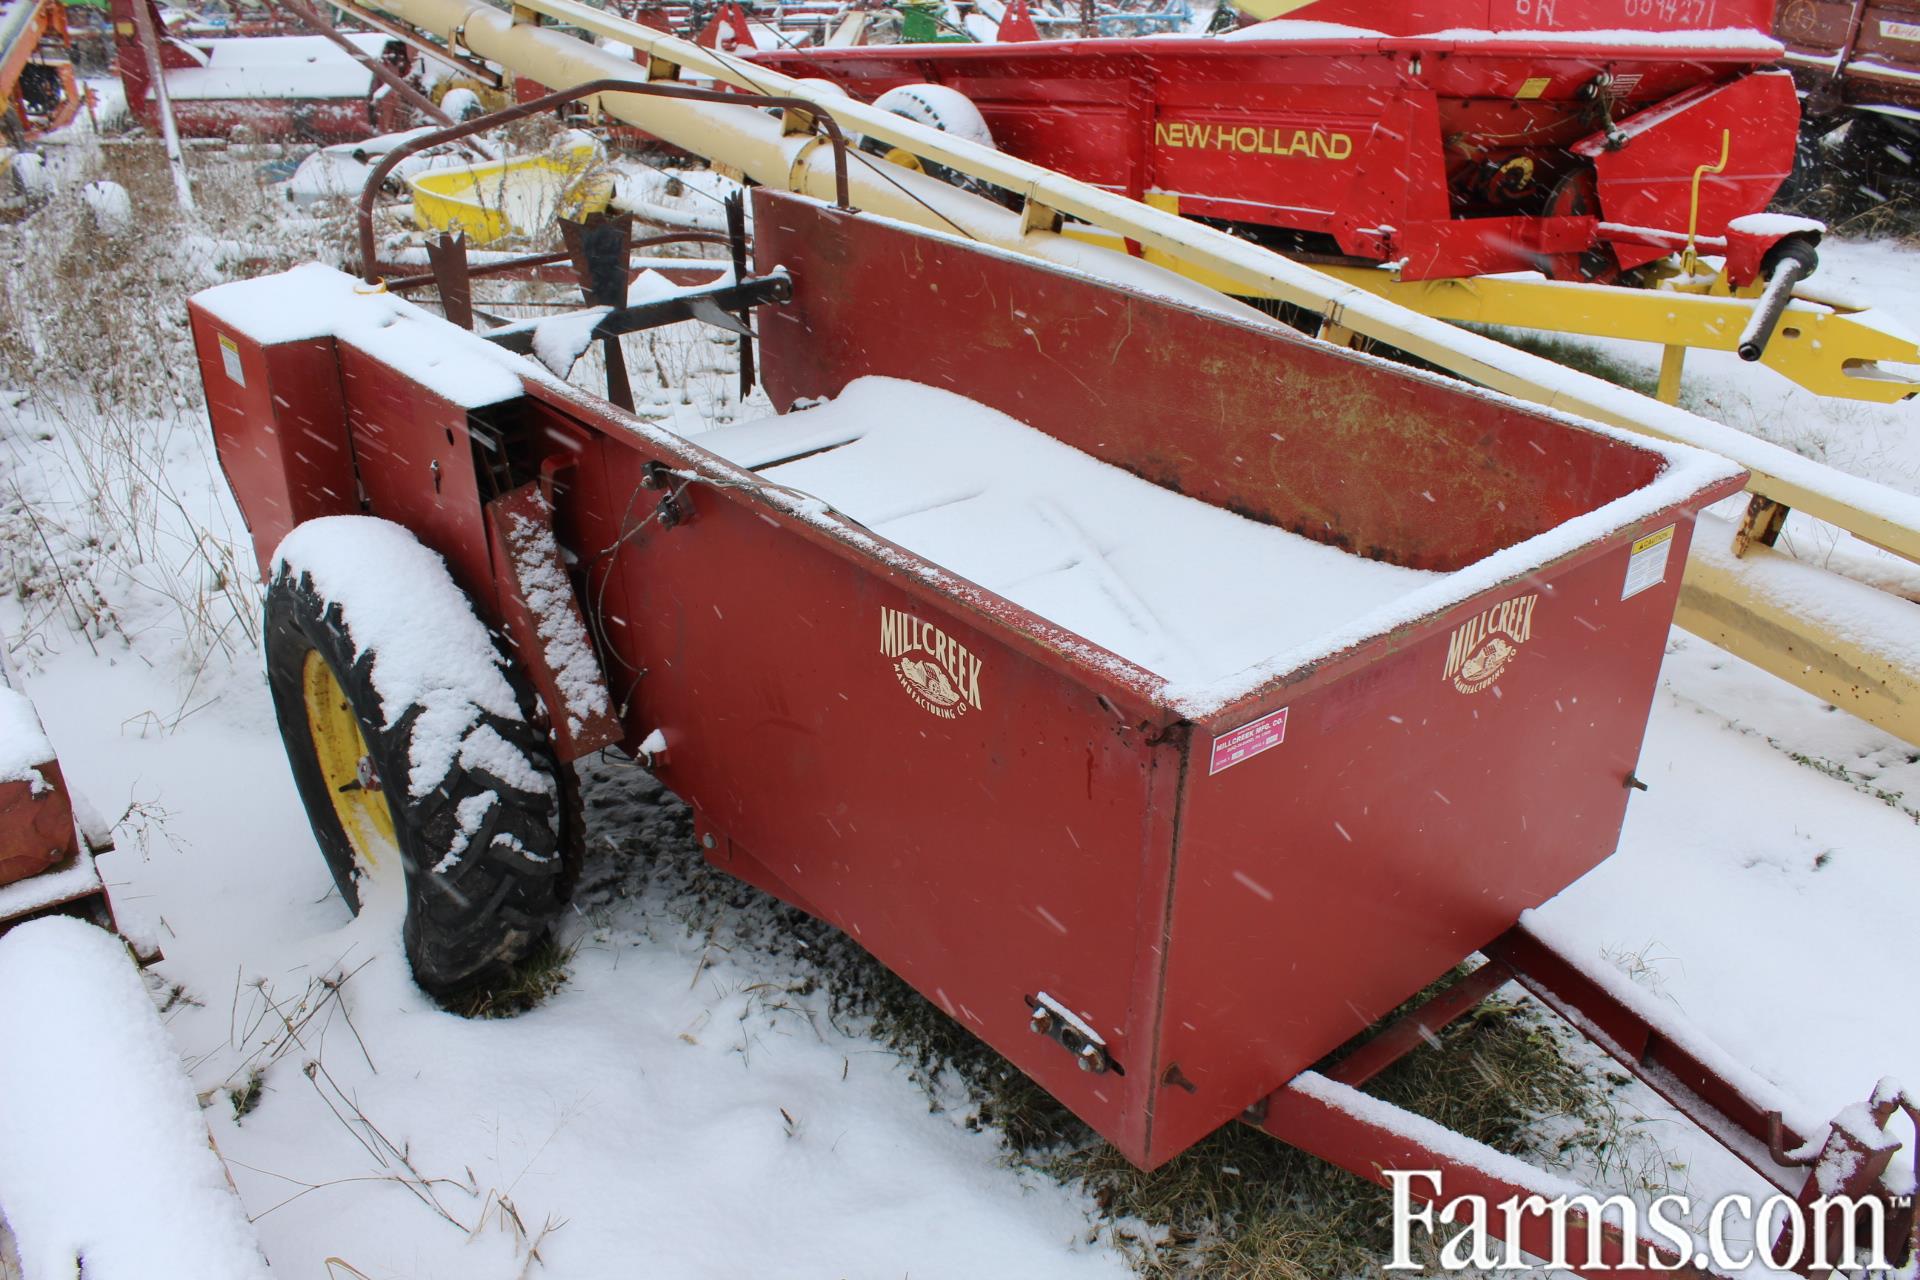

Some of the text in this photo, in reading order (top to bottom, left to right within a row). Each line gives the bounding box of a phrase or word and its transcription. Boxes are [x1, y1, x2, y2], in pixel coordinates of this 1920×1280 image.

[1155, 122, 1353, 160] NEW HOLLAND
[880, 605, 982, 711] MILLCREEK
[1442, 594, 1538, 681] MILLCREEK
[893, 663, 956, 719] MANUFACTURING
[1216, 730, 1255, 752] MILLCREEK
